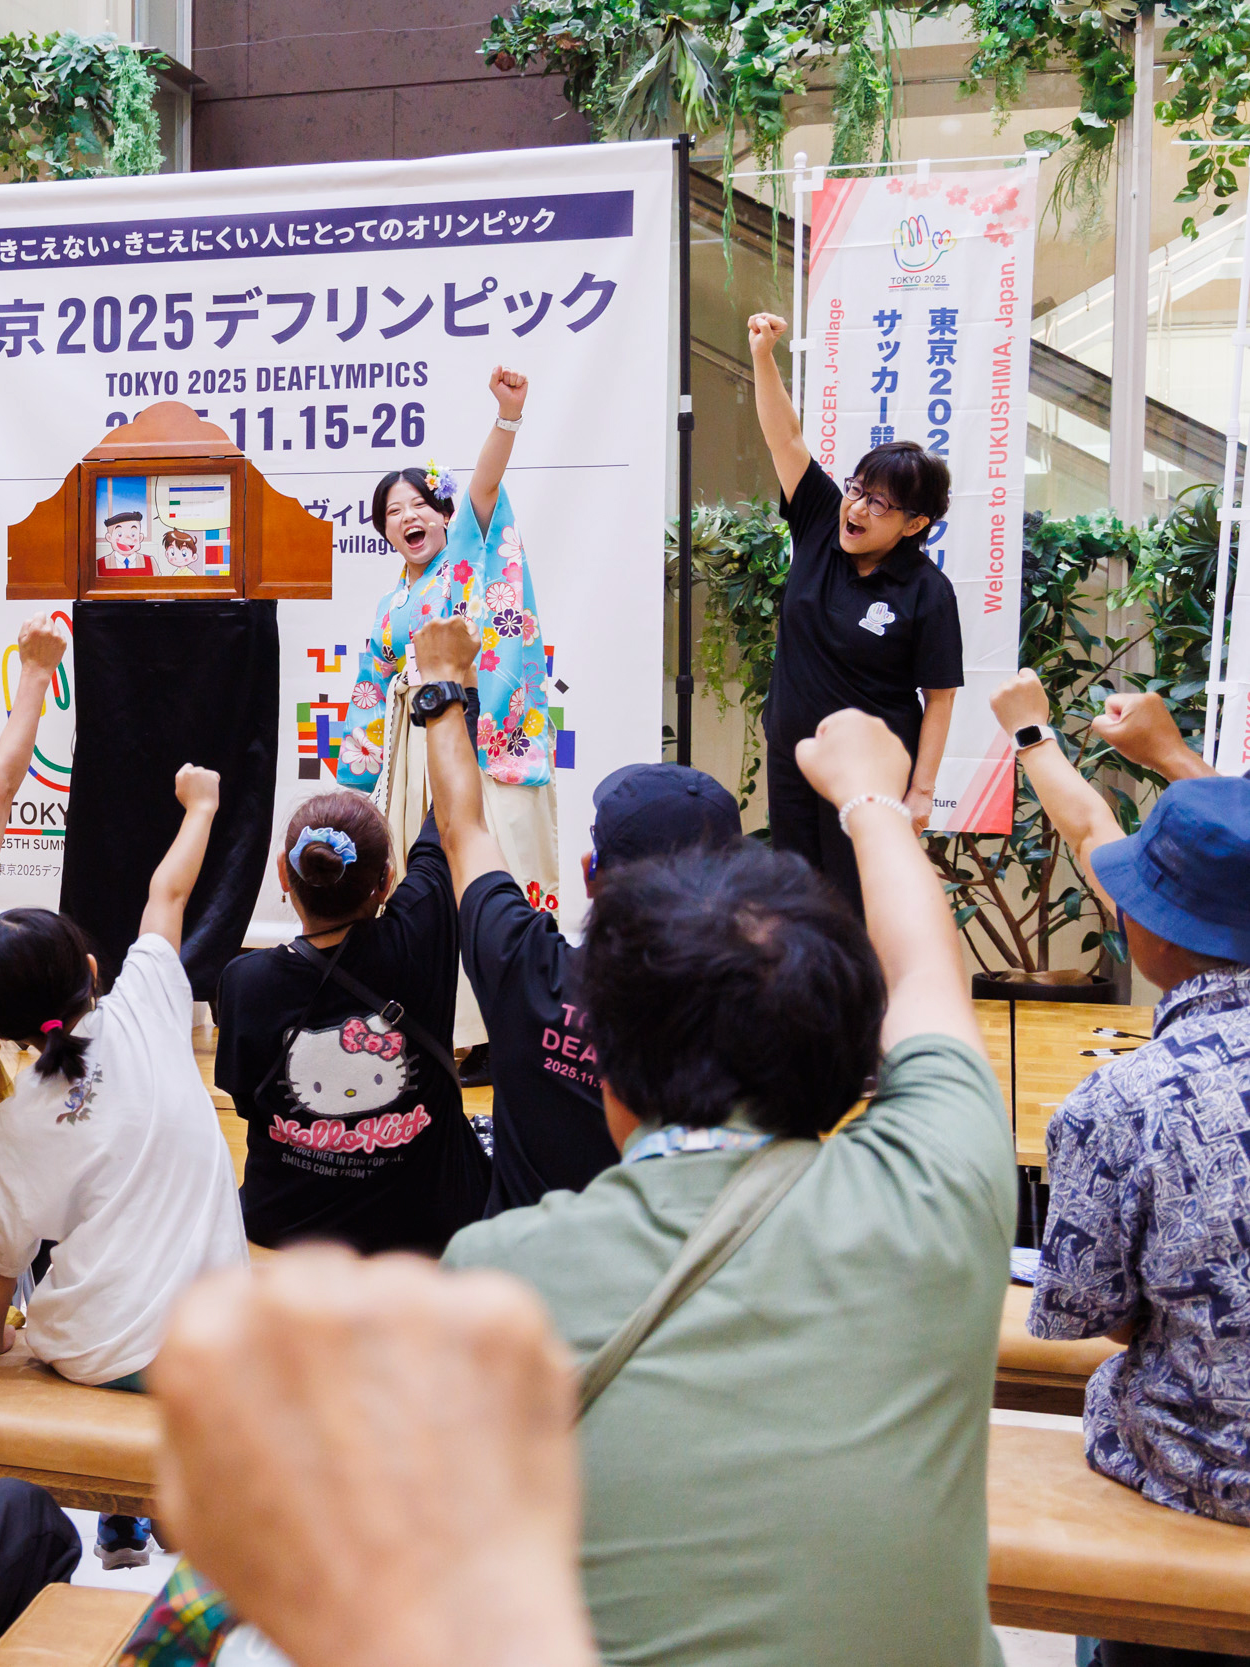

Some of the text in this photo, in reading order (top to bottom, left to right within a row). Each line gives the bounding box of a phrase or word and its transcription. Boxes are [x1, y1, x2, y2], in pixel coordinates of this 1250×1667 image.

[0, 207, 556, 263] きこえない・きこえにくい人にとってのオリンピック
[890, 275, 947, 285] TOKYO 2025
[824, 298, 845, 374] J-village
[105, 360, 428, 397] TOKYO 2025 DEAFLYMPICS
[106, 401, 425, 452] 11.15-26
[819, 380, 840, 466] SOCCER,
[983, 256, 1019, 615] Welcome to FUKUSHIMA, Japan.
